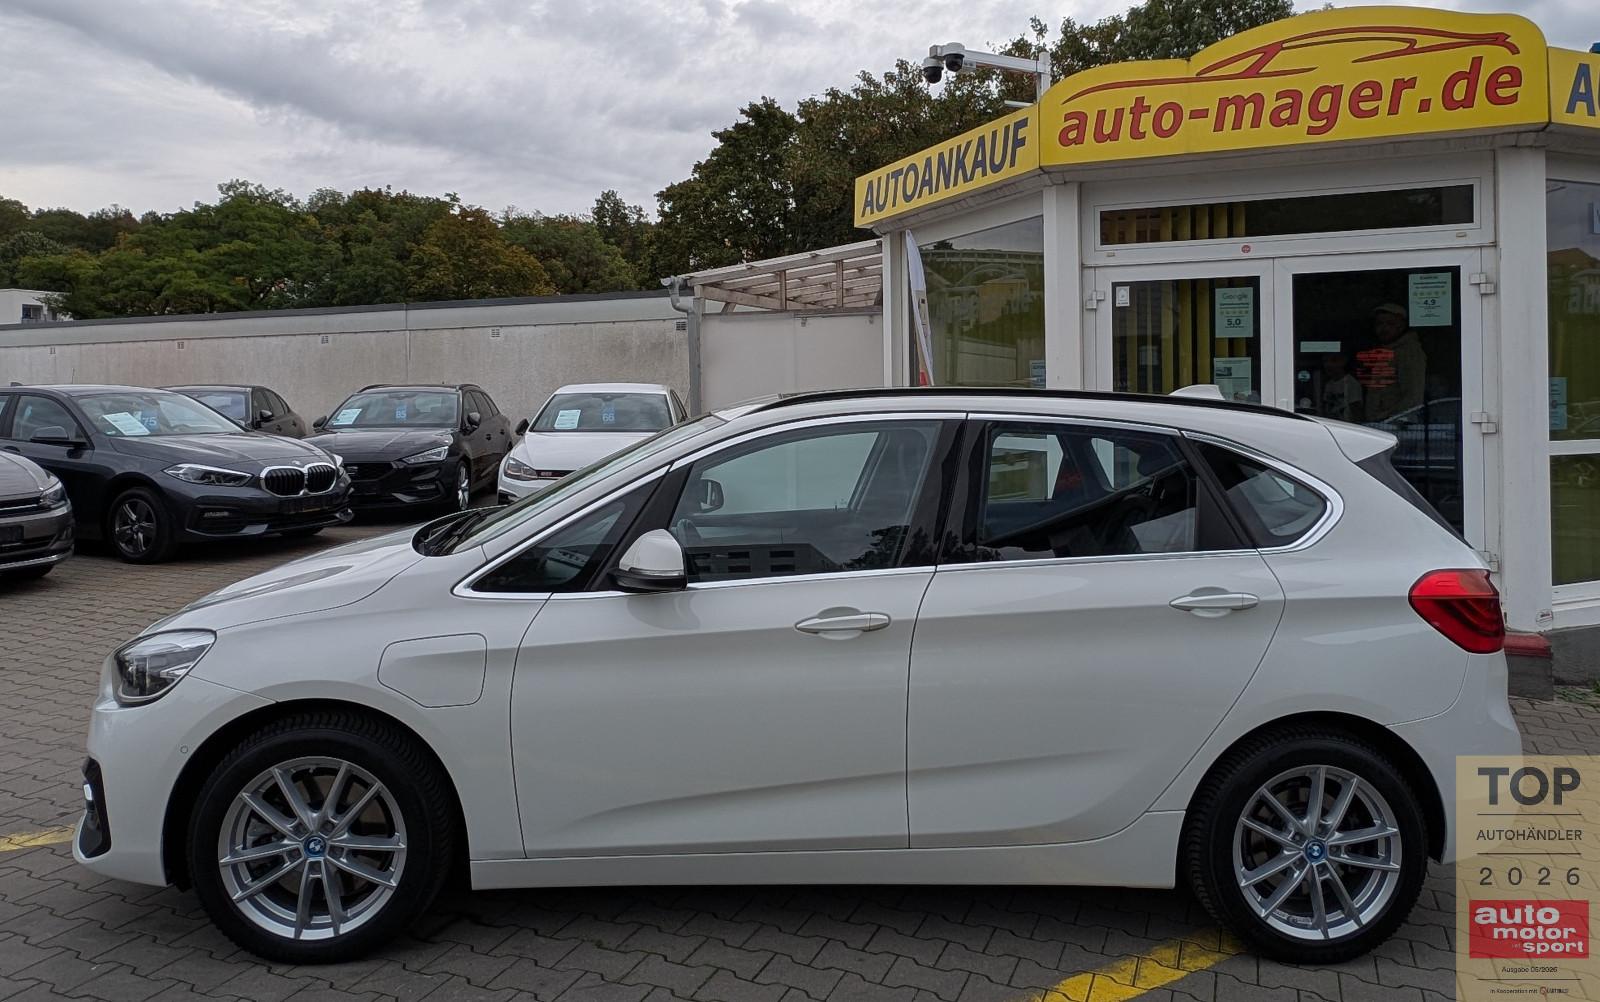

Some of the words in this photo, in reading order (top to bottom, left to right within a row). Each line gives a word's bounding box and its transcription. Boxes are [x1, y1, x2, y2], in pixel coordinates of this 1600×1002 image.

[1058, 56, 1523, 147] auto-mager.de
[1565, 62, 1600, 117] A
[861, 117, 1029, 217] AUTOANKAUF
